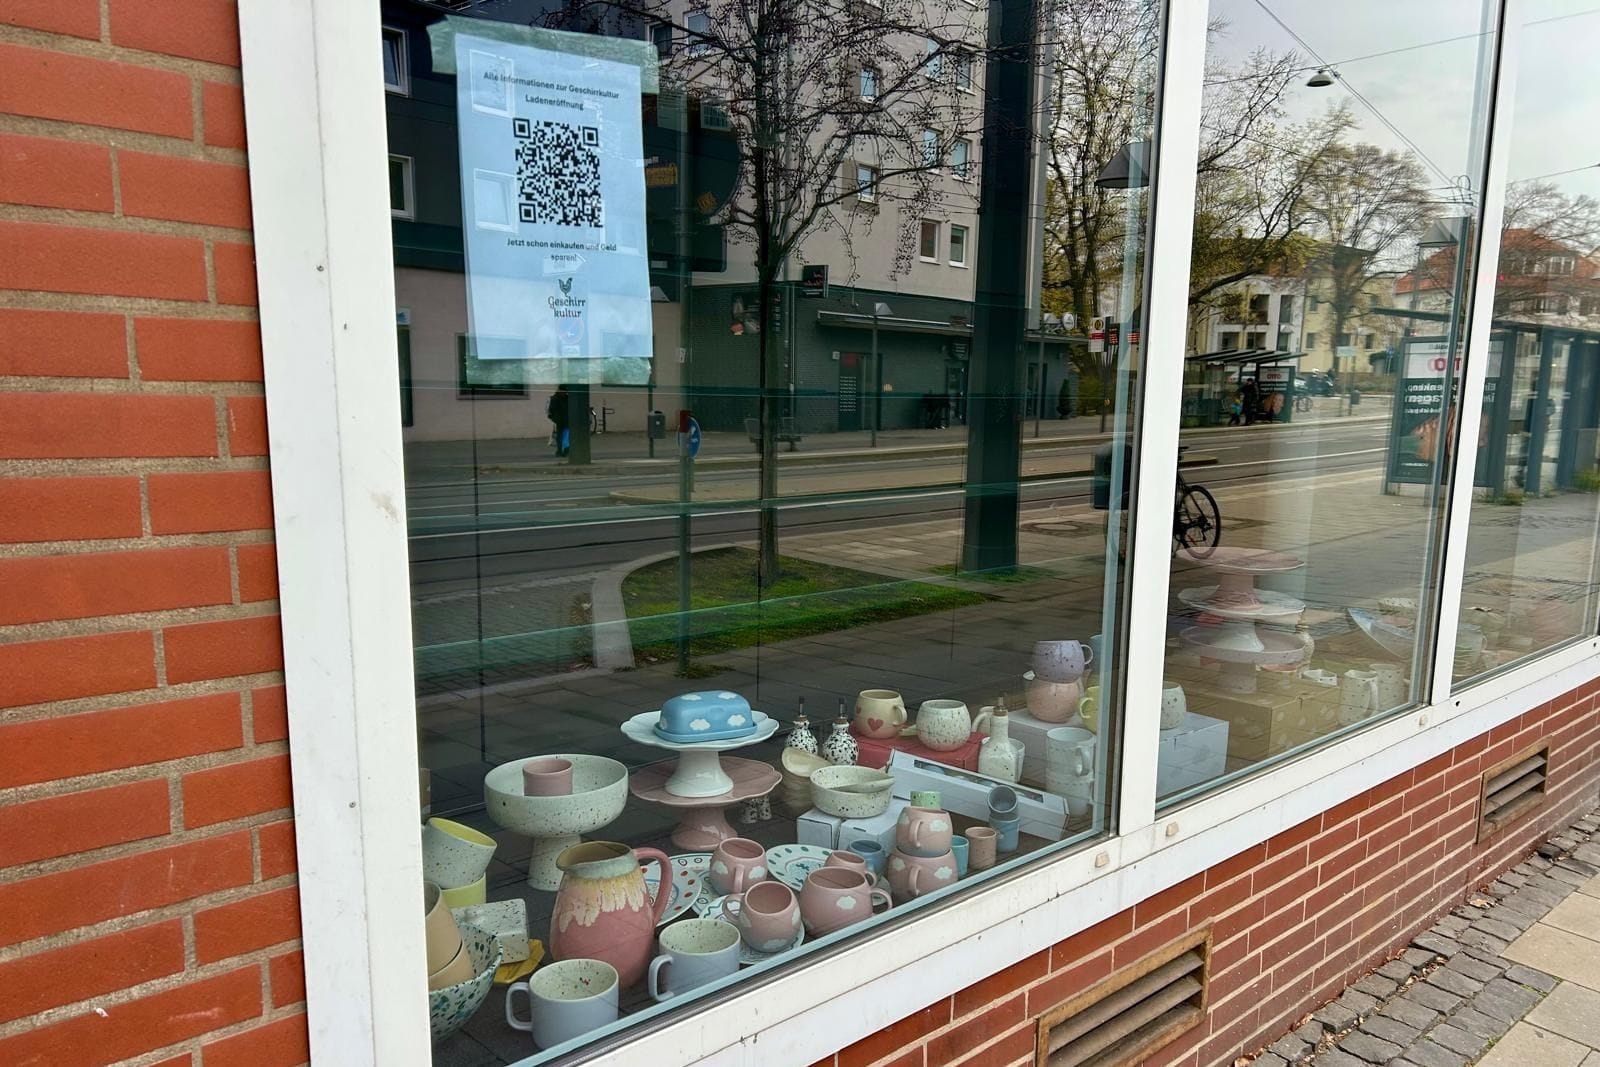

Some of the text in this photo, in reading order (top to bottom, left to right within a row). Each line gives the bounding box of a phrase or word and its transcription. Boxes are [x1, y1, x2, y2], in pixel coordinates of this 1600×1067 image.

[483, 71, 620, 99] Alle Informationen zur Geschirrkultur
[525, 94, 584, 111] Ladeneröffnung
[507, 238, 525, 247] Jetzt
[526, 239, 549, 248] schon
[550, 240, 585, 250] einkaufen
[600, 243, 617, 251] Geld
[550, 254, 577, 262] sparen!
[547, 295, 586, 309] Geschirr
[554, 308, 582, 318] kultur
